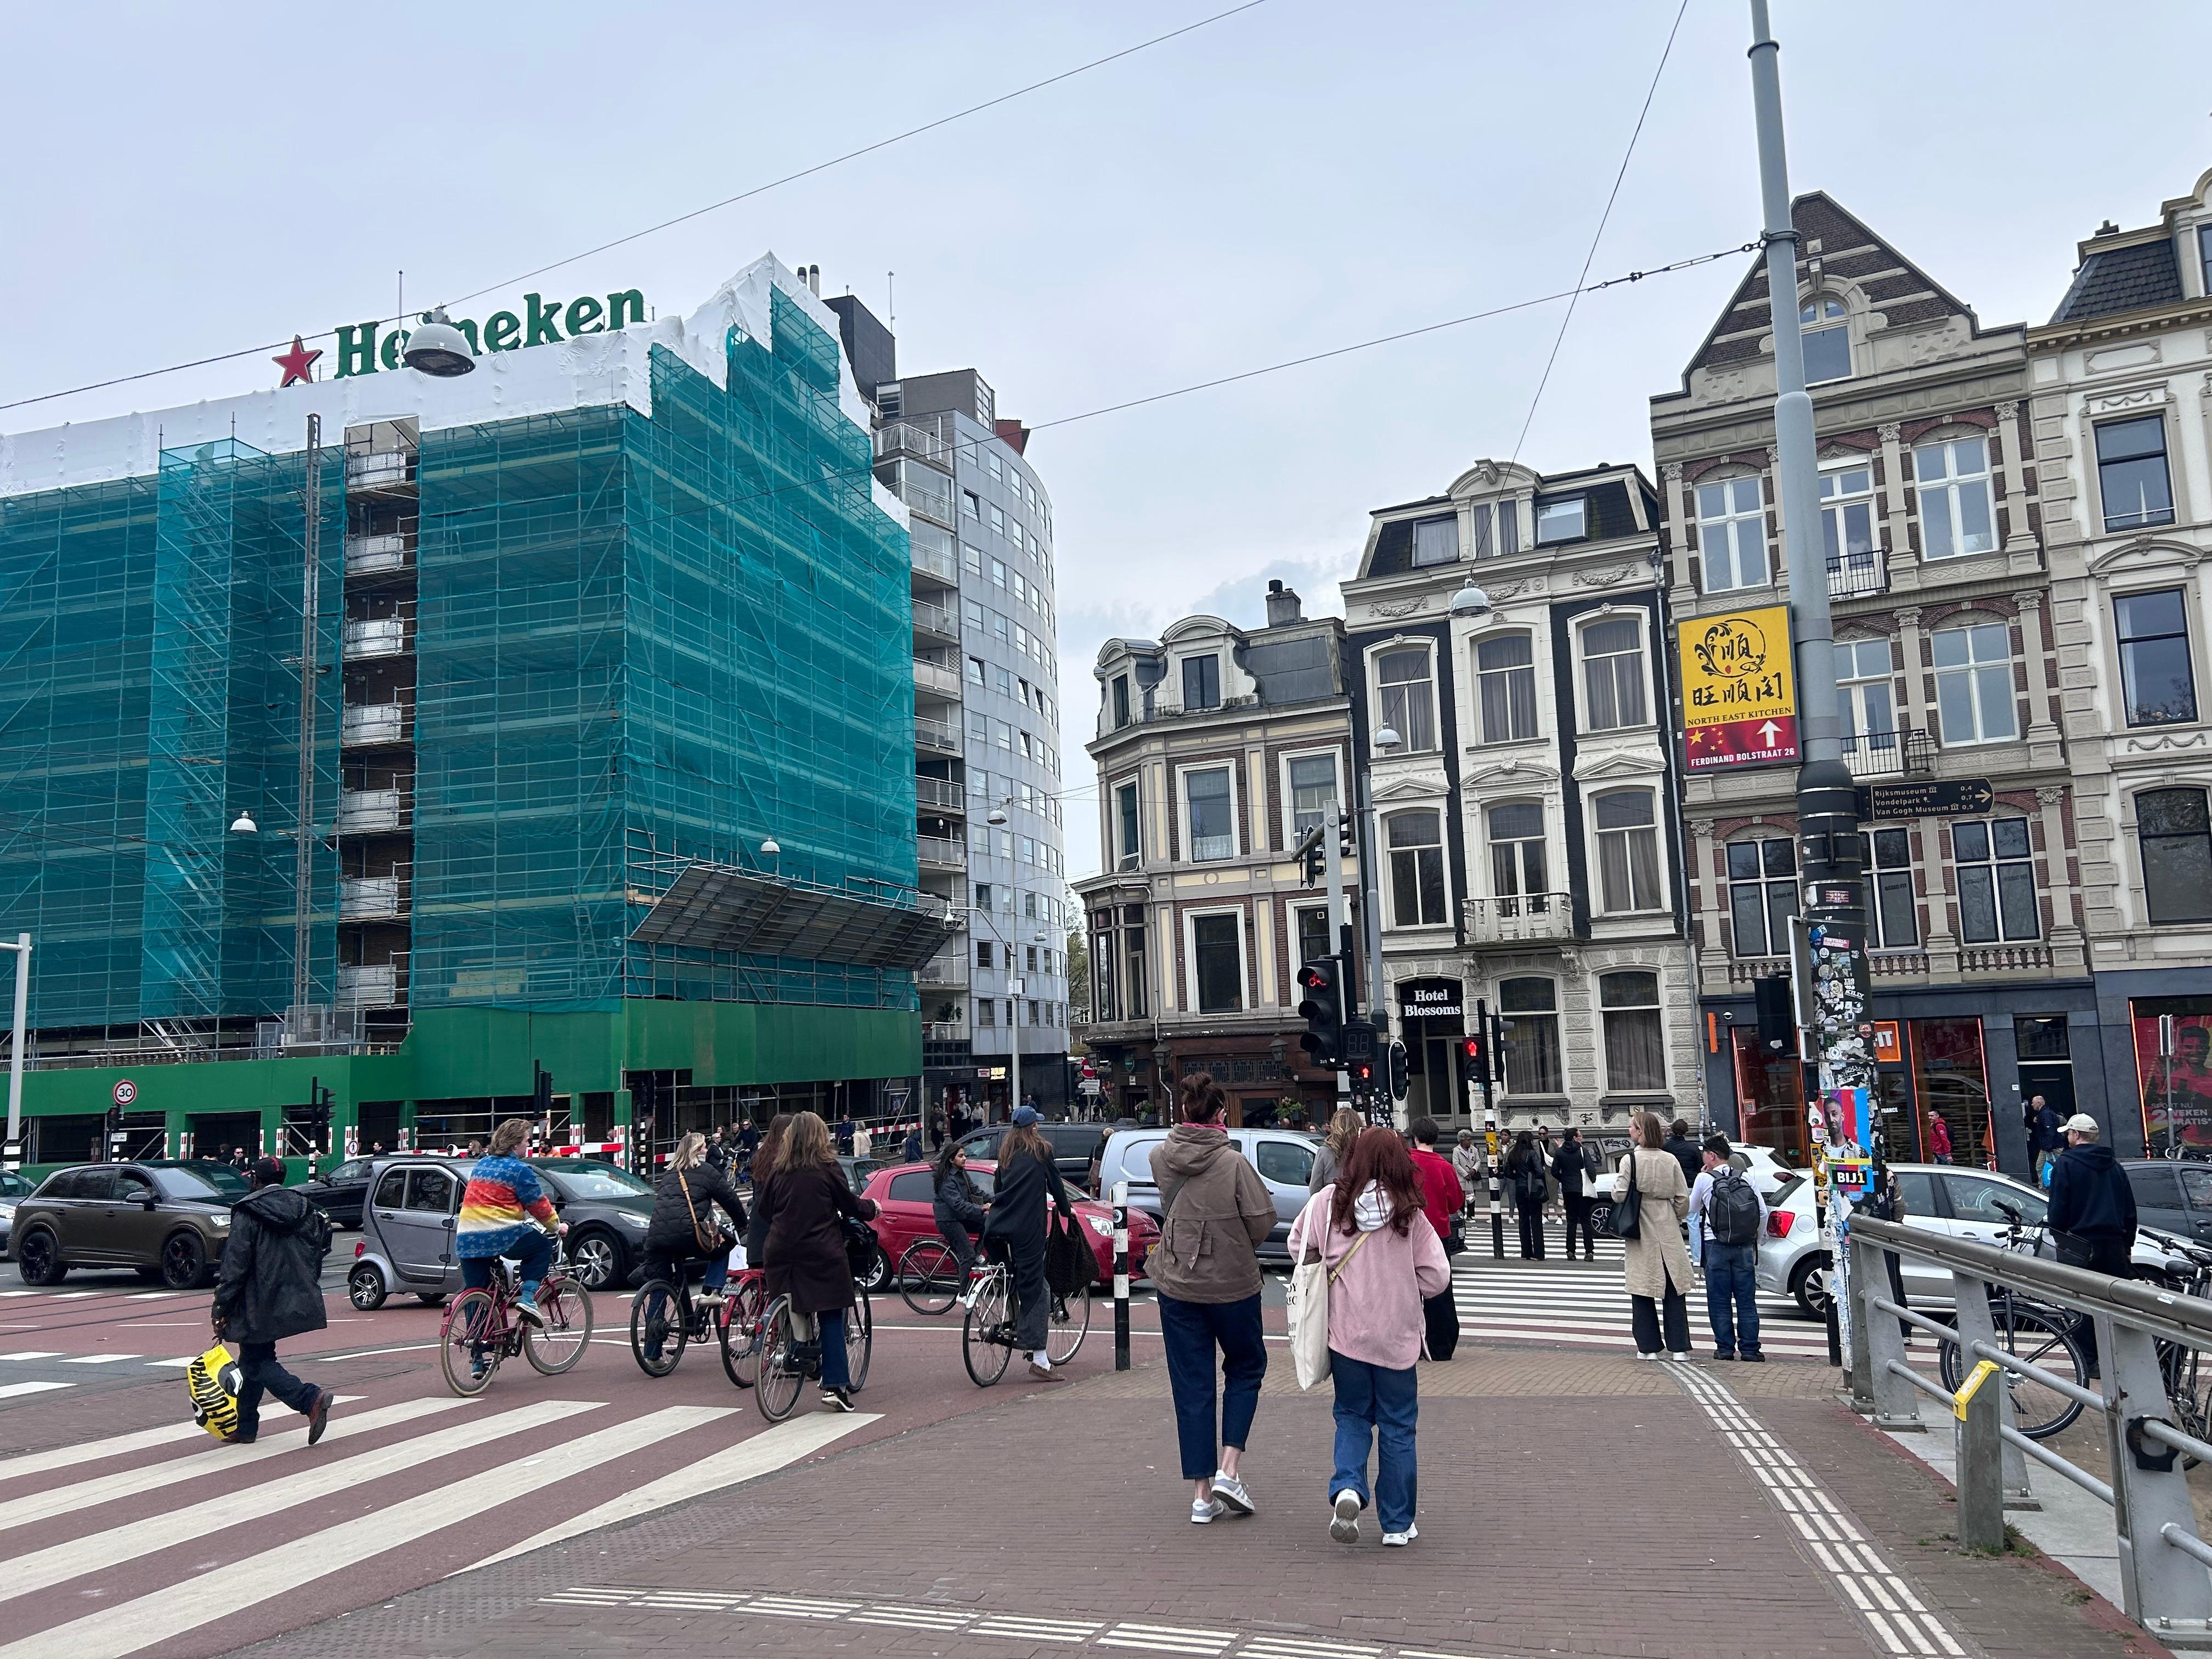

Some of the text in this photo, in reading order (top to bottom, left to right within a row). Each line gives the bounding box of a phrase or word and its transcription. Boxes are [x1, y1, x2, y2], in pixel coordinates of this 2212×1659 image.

[334, 289, 645, 380] Heneken
[1688, 707, 1792, 726] NORTH EAST KITCHEN
[1691, 747, 1795, 766] FERDINAND BOLSTRAAT 26
[1875, 787, 1927, 797] Rijksmuseum
[1875, 797, 1920, 806] Vondelpark
[1414, 989, 1448, 1001] Hotel
[1404, 1005, 1461, 1017] Blossoms
[119, 1088, 133, 1097] 30
[2152, 1109, 2169, 1126] 2
[1837, 1172, 1865, 1183] BIJ1
